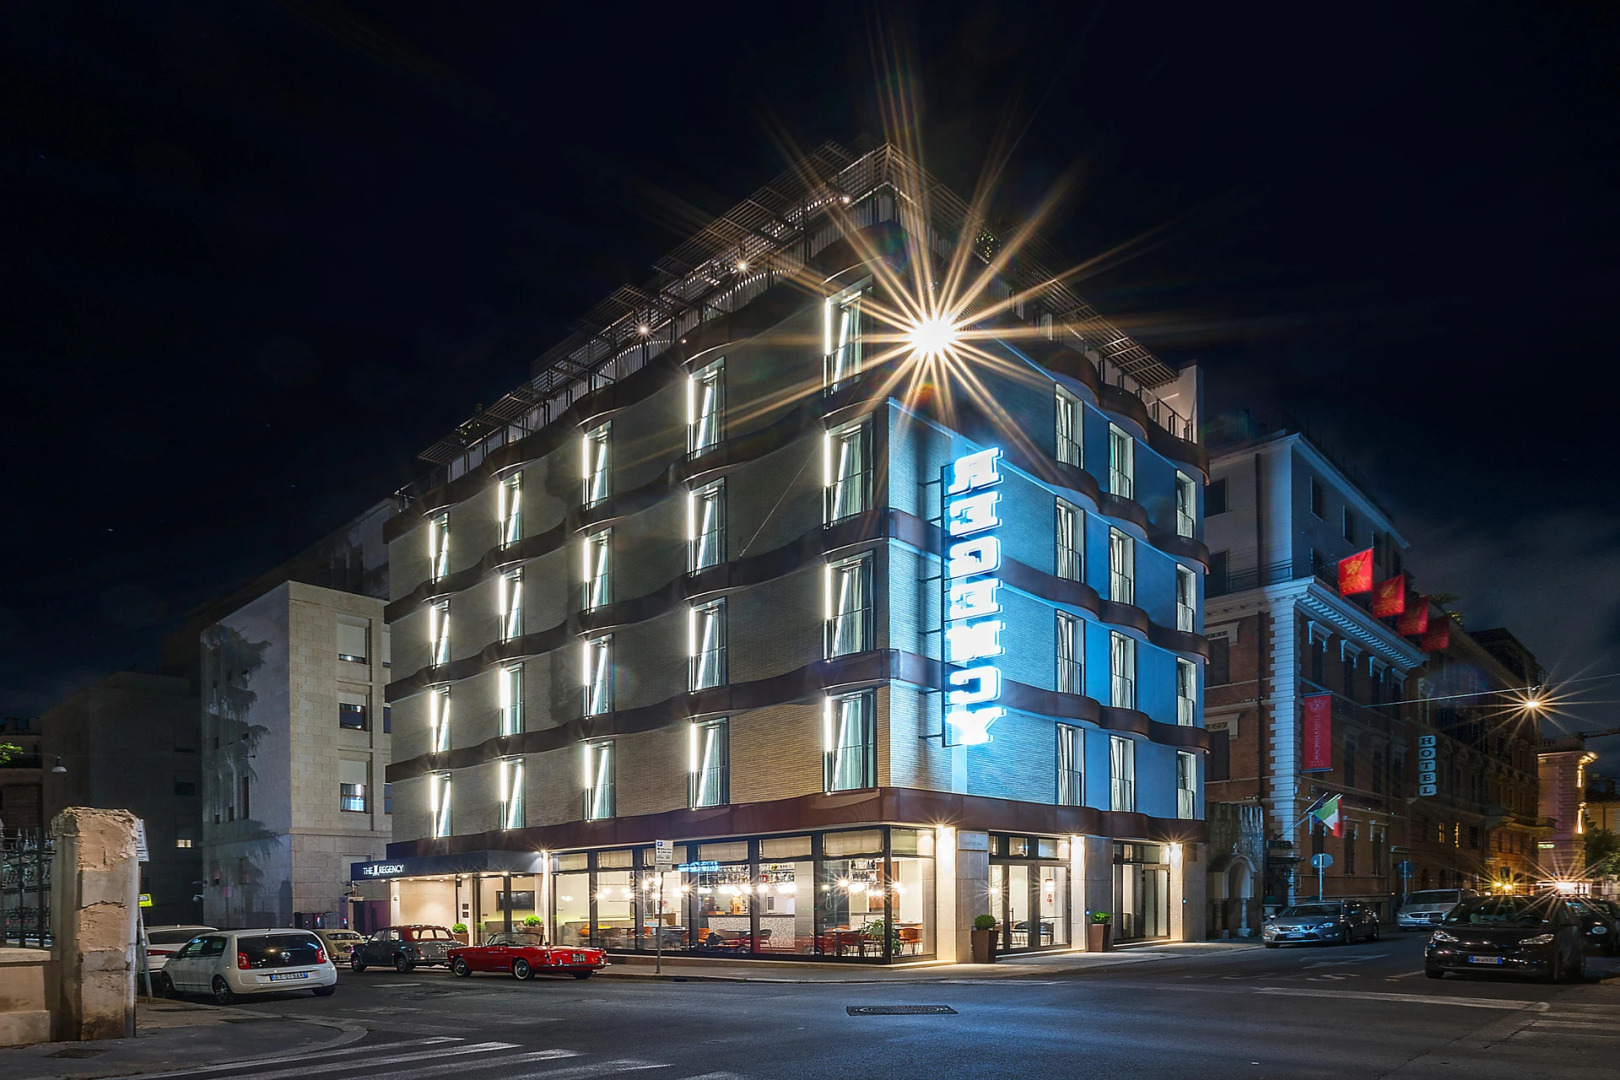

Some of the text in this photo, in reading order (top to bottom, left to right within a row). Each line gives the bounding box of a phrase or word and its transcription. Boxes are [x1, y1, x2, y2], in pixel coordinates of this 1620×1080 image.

[1420, 736, 1433, 795] HOTEL
[363, 864, 404, 875] THE REGENCY
